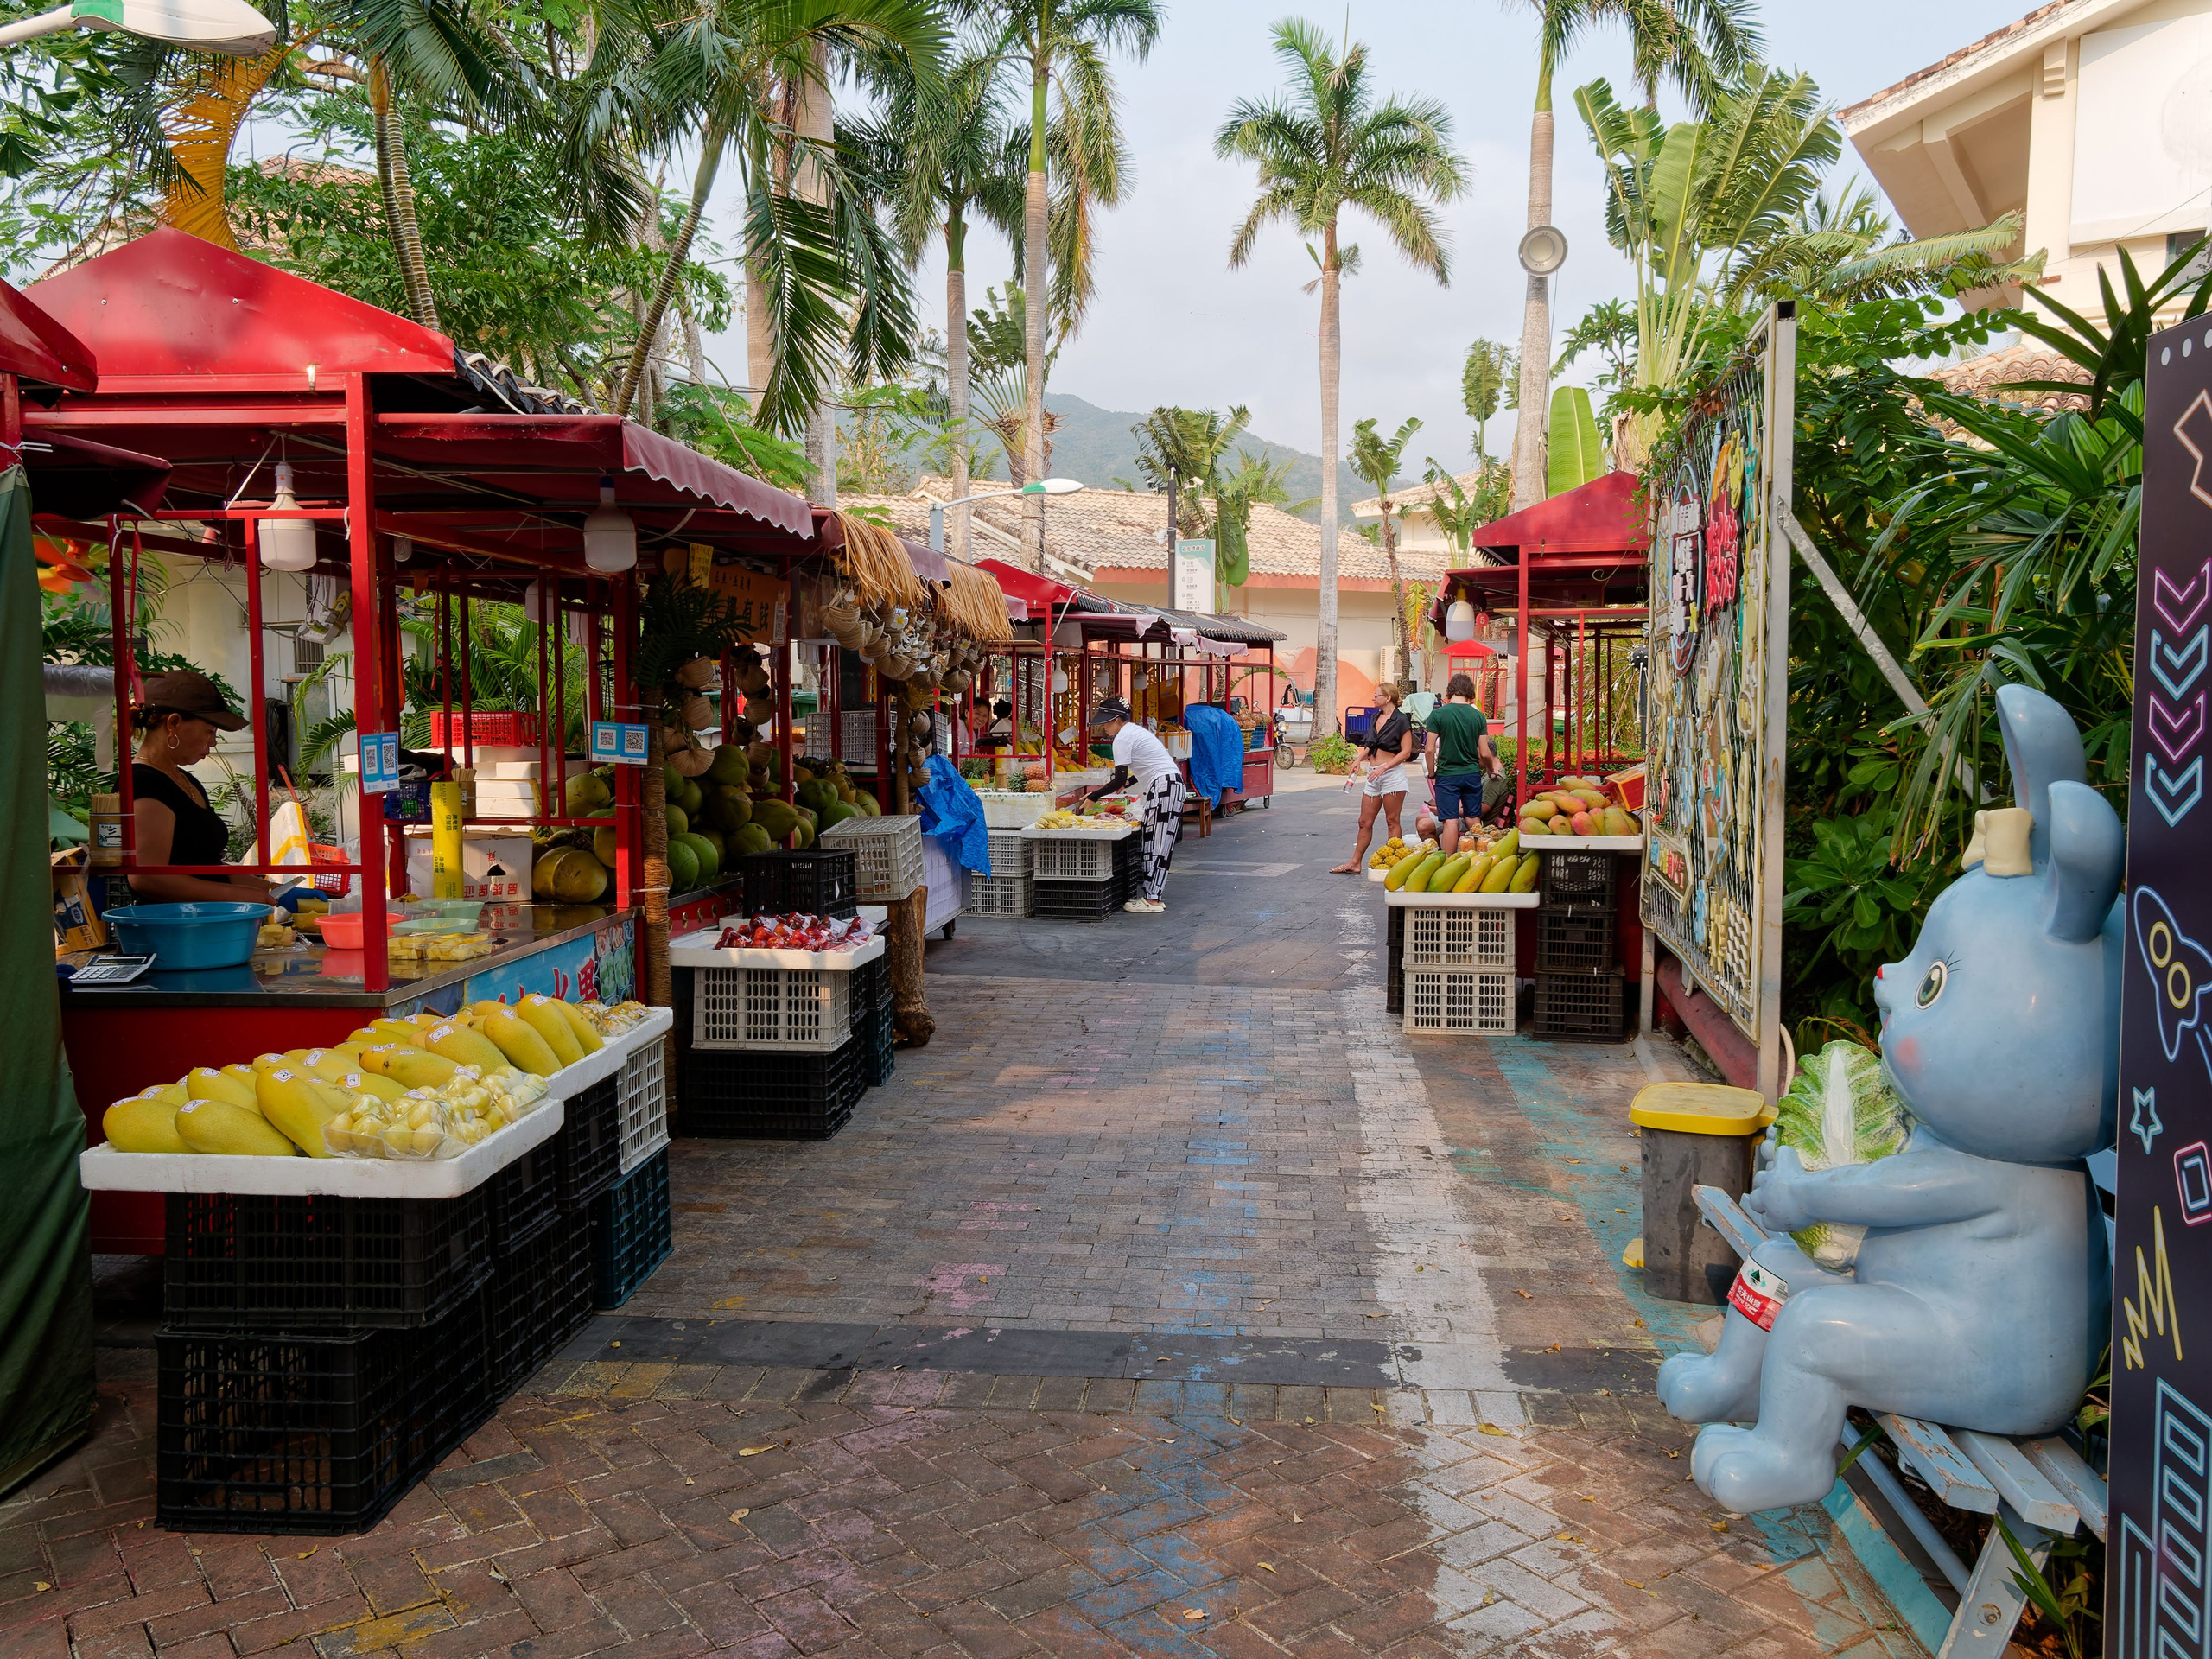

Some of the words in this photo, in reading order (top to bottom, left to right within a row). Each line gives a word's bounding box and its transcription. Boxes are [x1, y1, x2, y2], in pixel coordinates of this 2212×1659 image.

[1479, 616, 1486, 625] 5
[463, 882, 518, 899] 品质保证
